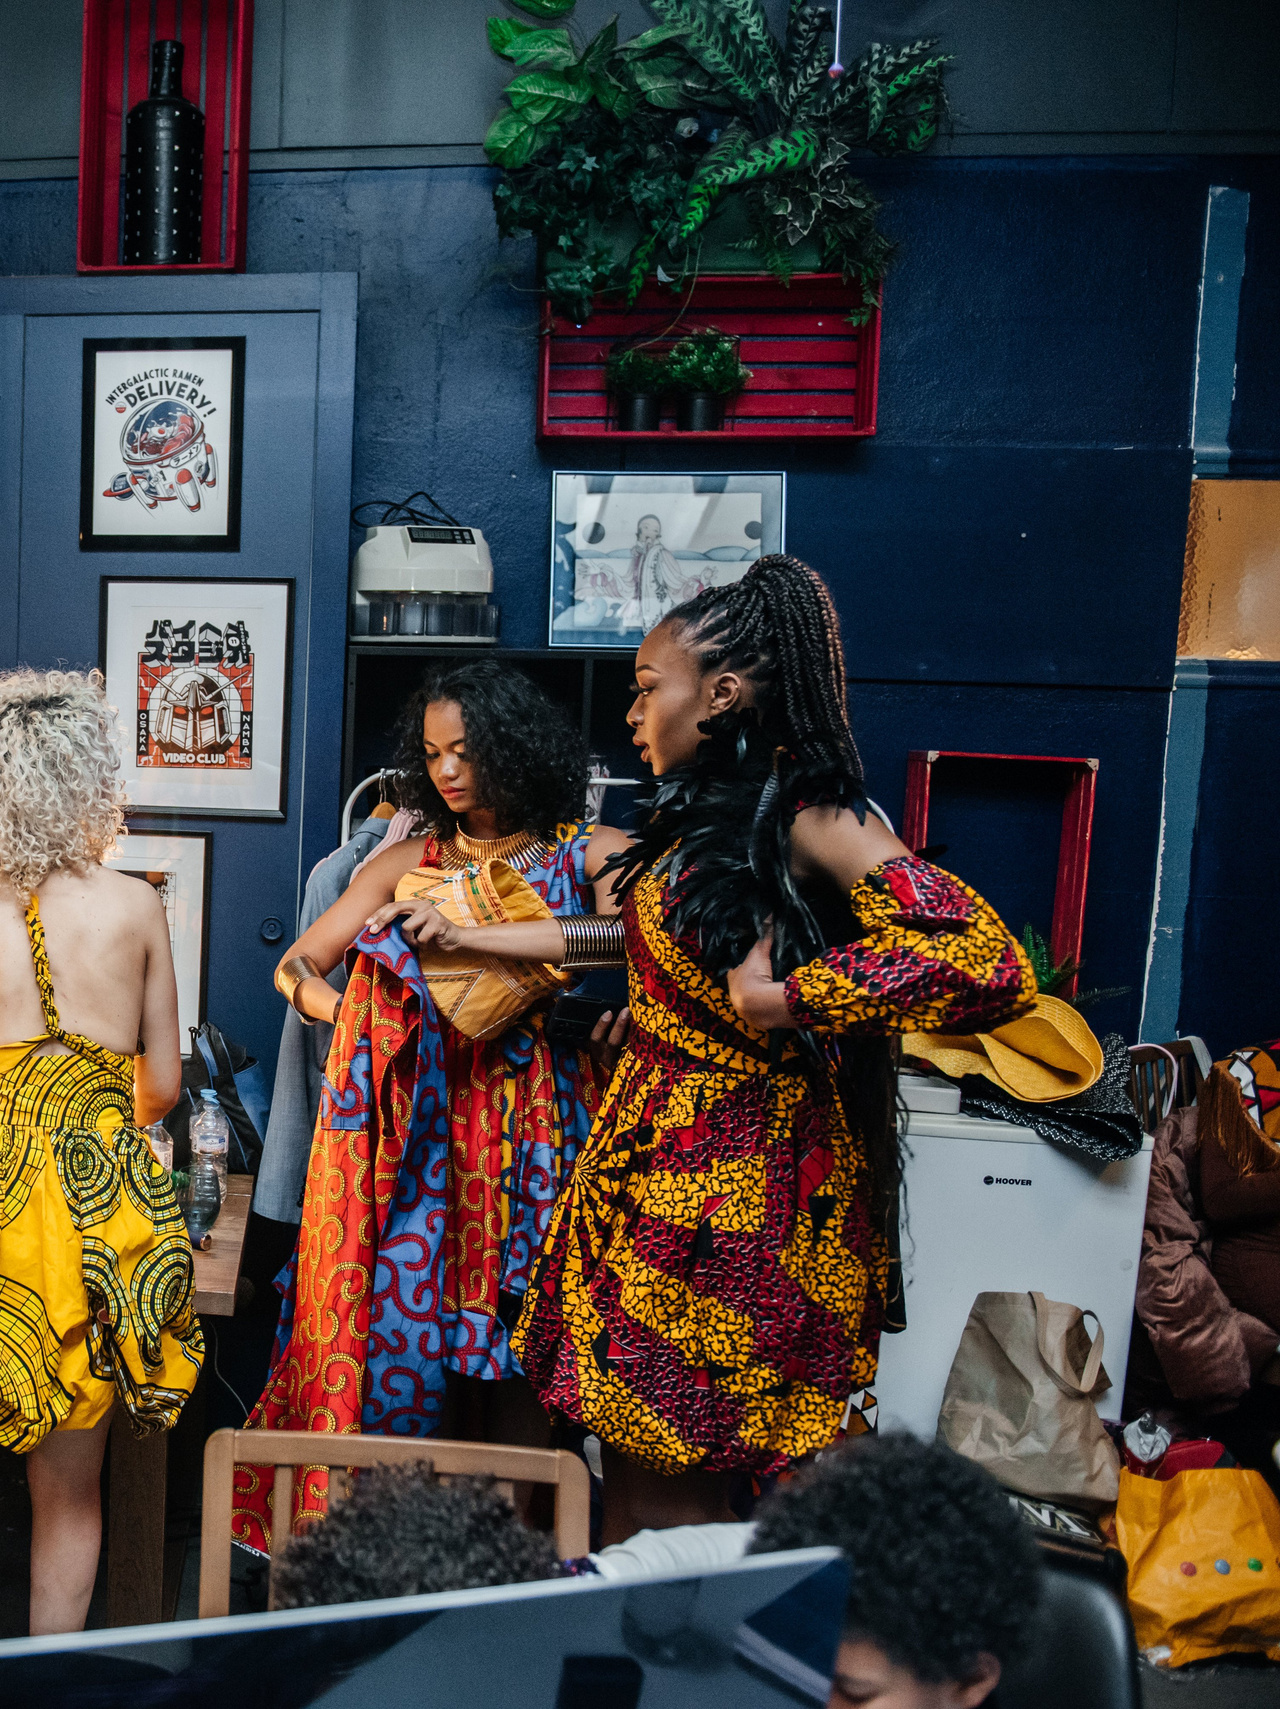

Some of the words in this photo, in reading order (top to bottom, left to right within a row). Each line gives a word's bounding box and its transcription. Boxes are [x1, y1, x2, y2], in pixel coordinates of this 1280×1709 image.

[105, 368, 169, 405] INTERGALACTIC
[172, 368, 204, 387] RAMEN
[139, 712, 147, 752] OSAKA
[242, 714, 251, 754] NAMBA
[163, 752, 196, 763] VIDEO
[196, 753, 227, 764] CLUB
[995, 1177, 1032, 1186] HOOVER
